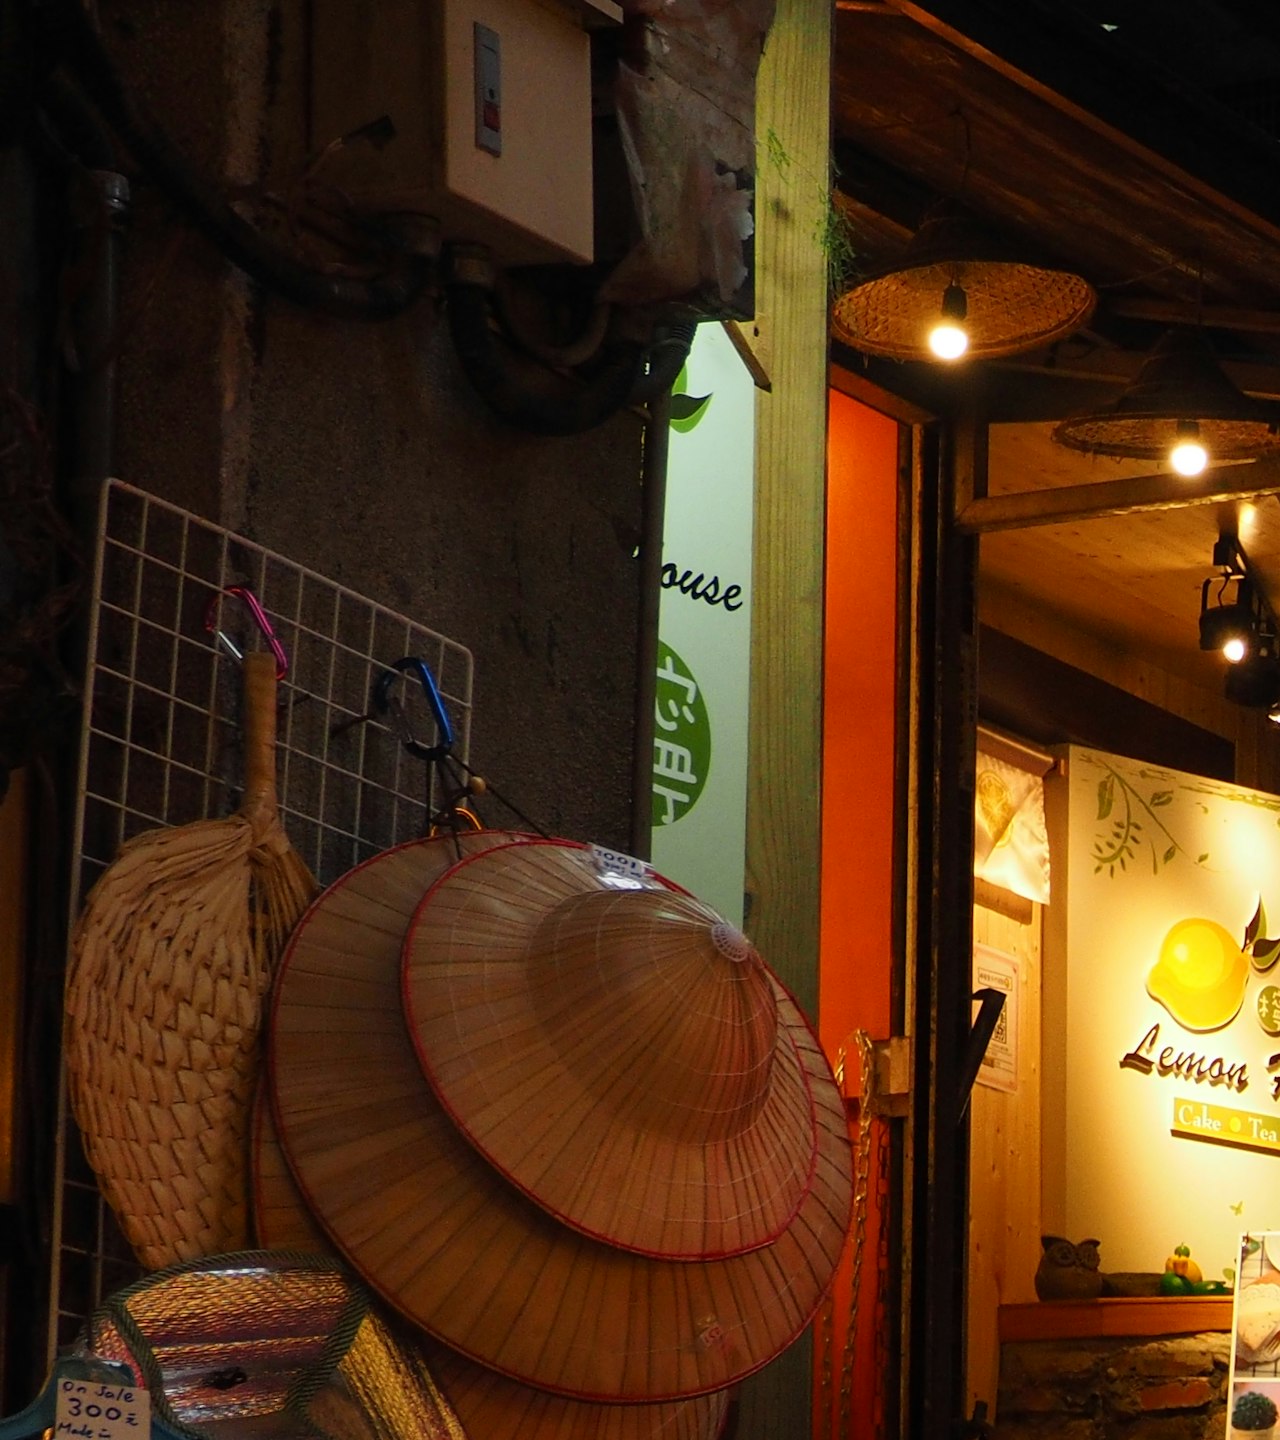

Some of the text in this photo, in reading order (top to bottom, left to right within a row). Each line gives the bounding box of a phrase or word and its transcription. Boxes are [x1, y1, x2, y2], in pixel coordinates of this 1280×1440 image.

[660, 561, 743, 612] ouse
[1121, 1023, 1249, 1090] Lemon
[1178, 1103, 1222, 1132] Cake
[1248, 1116, 1278, 1143] Tea
[63, 1381, 135, 1403] On Sale
[58, 1422, 92, 1438] Made
